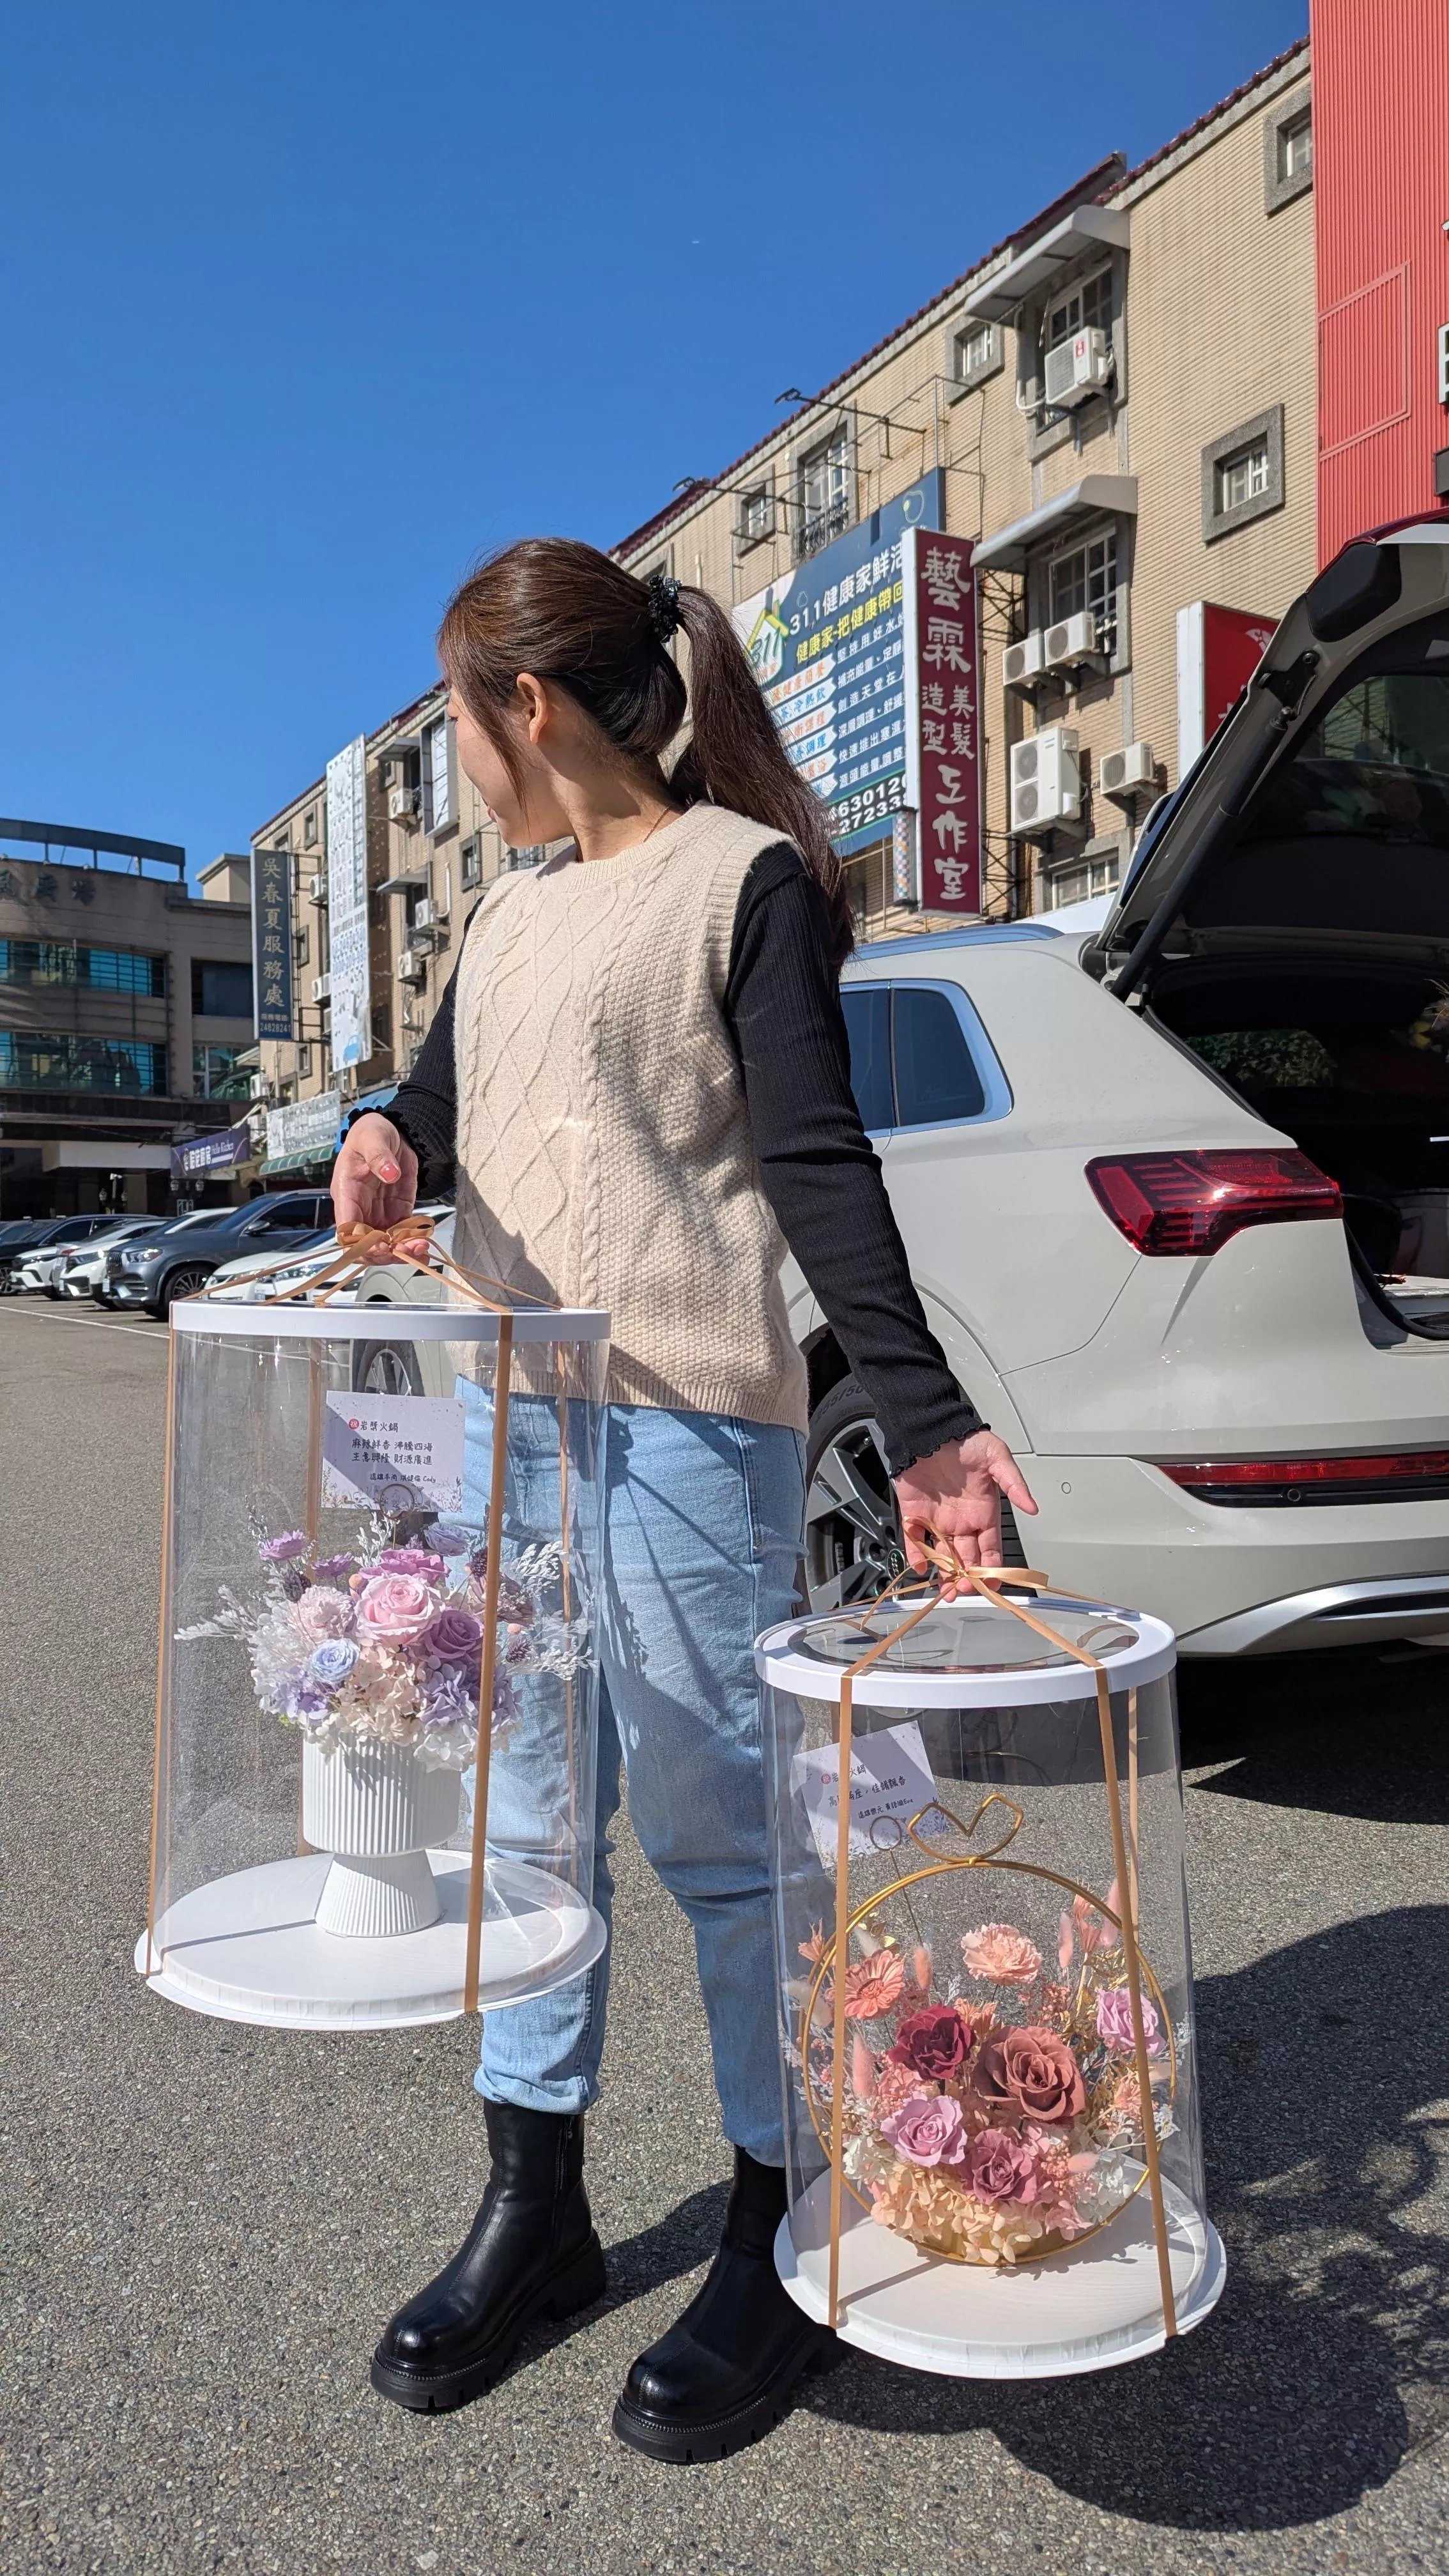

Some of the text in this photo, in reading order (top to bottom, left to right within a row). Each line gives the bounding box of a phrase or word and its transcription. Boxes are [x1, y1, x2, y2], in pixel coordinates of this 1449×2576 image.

[921, 546, 972, 673] 藝霖
[838, 719, 905, 763] 快速排出寒濕
[933, 765, 969, 900] 工作室
[261, 859, 286, 1008] 吳春夏服務處
[832, 1764, 867, 1782] 岩火鍋
